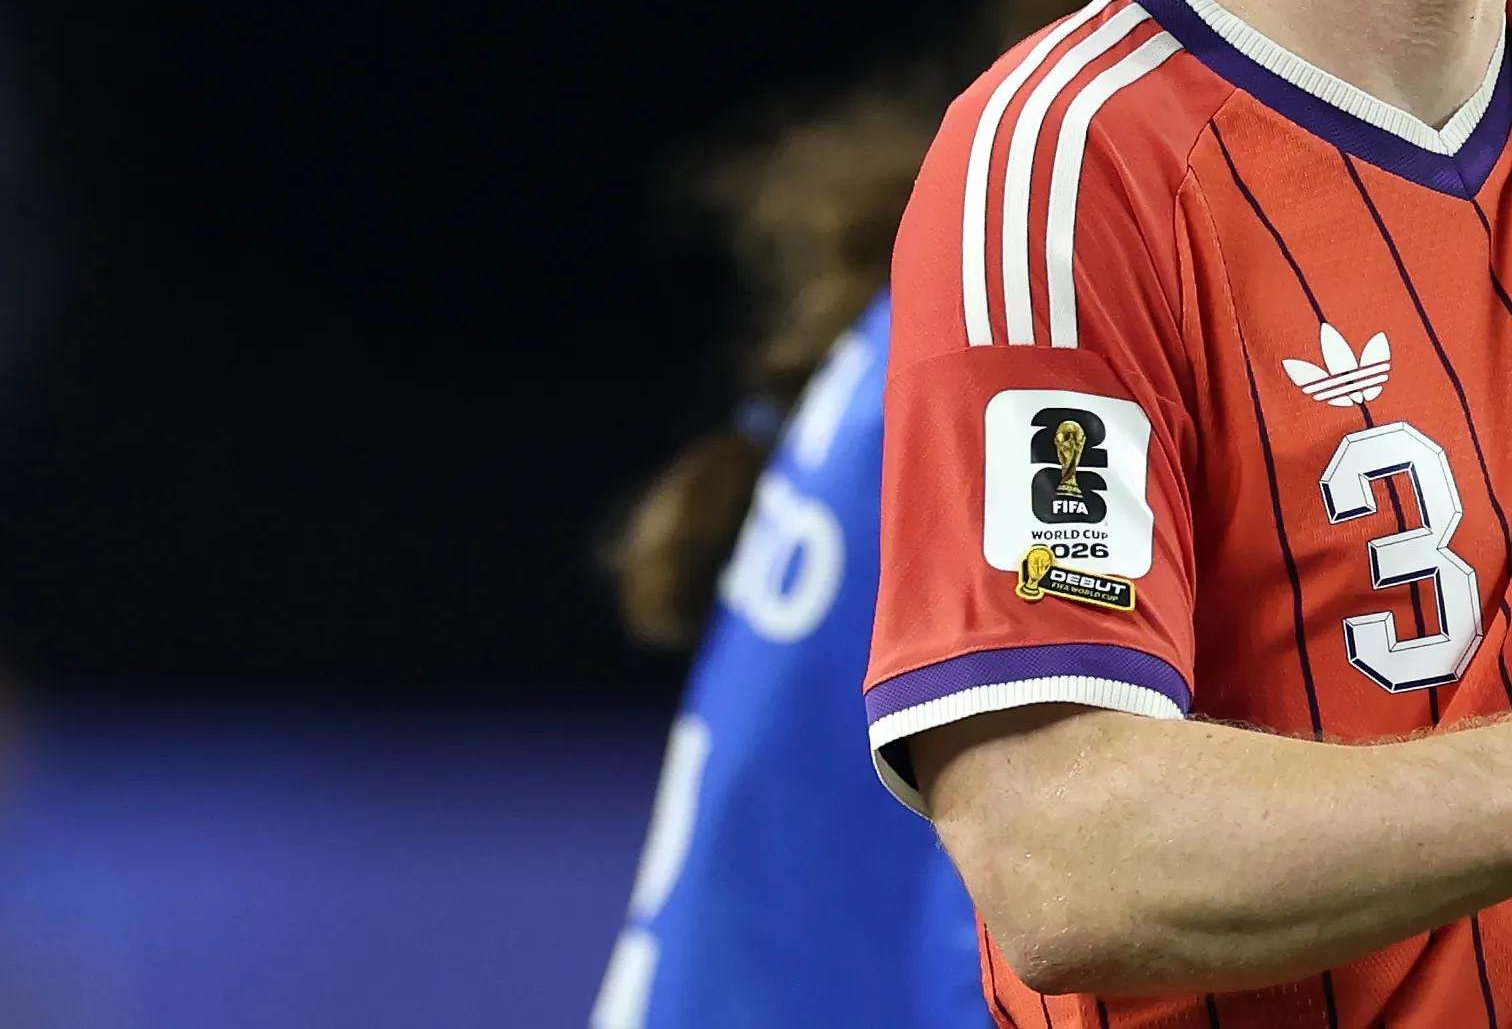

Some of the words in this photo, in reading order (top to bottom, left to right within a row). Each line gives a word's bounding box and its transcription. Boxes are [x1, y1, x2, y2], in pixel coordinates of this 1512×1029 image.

[1052, 500, 1089, 515] FIFA
[1031, 530, 1080, 540] WORLD
[1083, 529, 1109, 540] CUP
[1031, 543, 1110, 559] 026
[1319, 421, 1484, 694] 3
[1050, 569, 1126, 595] DEBUT
